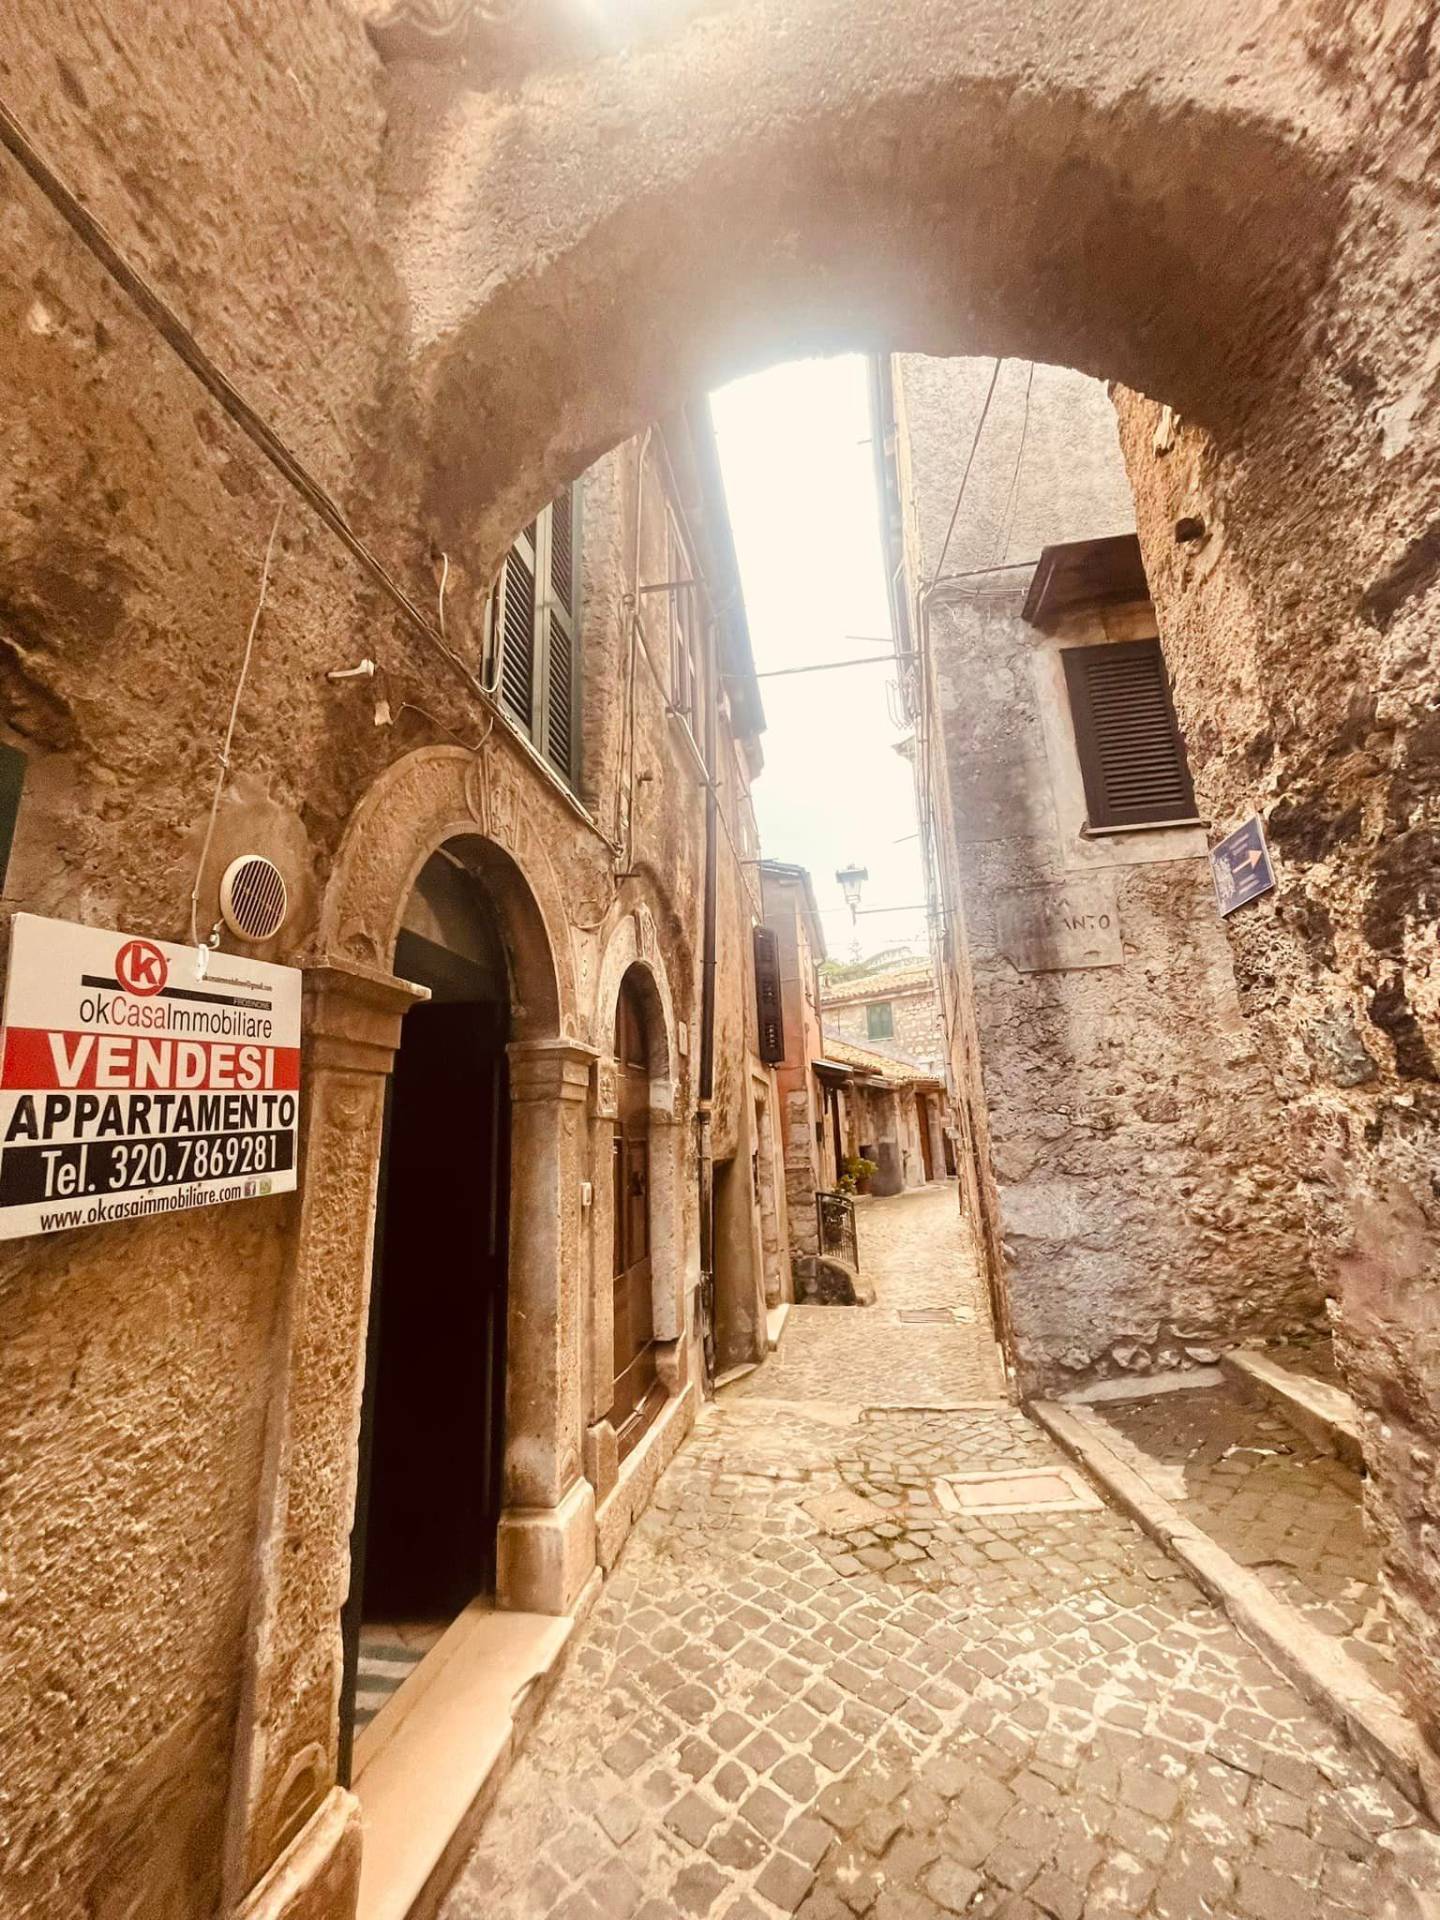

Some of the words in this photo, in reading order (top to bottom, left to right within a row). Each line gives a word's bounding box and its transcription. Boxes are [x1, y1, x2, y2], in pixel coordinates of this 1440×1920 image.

[80, 993, 272, 1038] okCasaImmobiliare
[48, 1033, 274, 1090] VENDESI
[5, 1094, 296, 1142] APPARTAMENTO
[40, 1144, 96, 1197] Tel.
[108, 1134, 277, 1189] 320.7869281
[40, 1184, 242, 1231] www.okcasaimmobiliare.com
